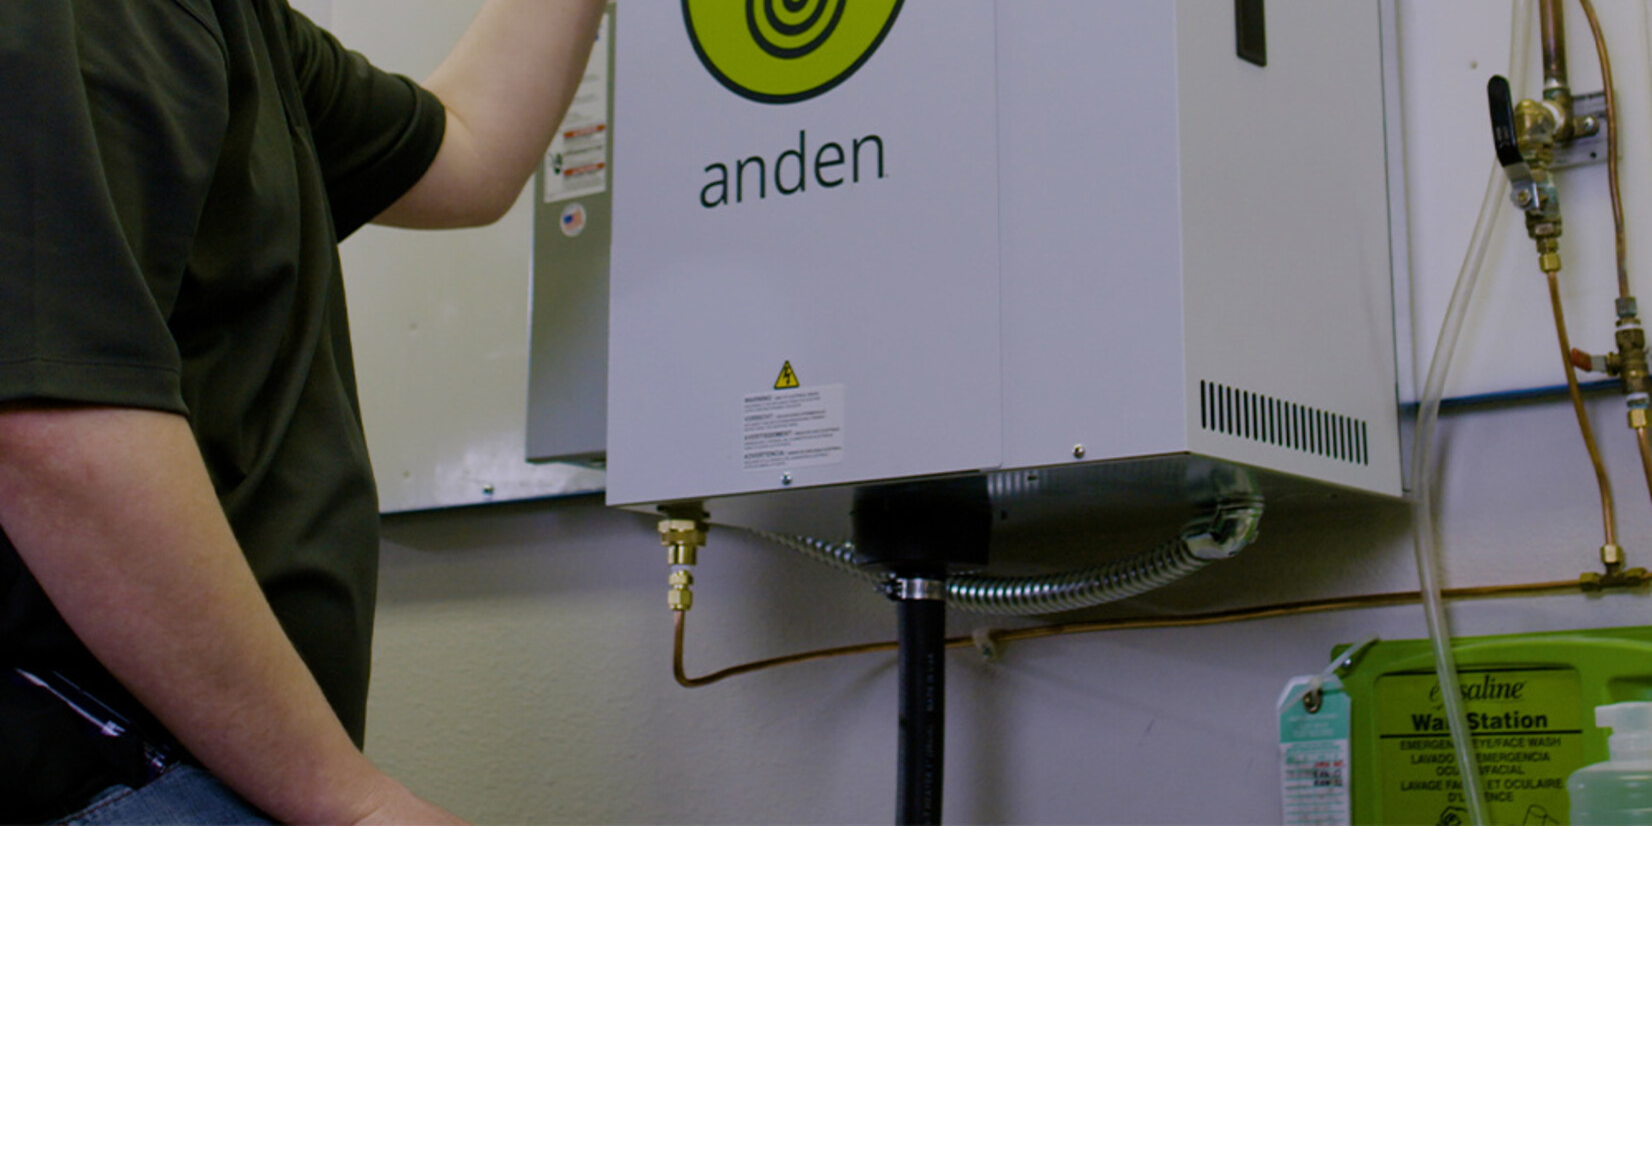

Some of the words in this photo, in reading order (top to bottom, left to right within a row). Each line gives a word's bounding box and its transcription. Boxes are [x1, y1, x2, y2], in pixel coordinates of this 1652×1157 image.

[700, 129, 884, 209] anden
[1466, 711, 1548, 730] Station
[1527, 736, 1562, 747] WASH
[1410, 753, 1455, 765] LAVADO
[1401, 779, 1443, 791] LAVAGE
[1488, 779, 1501, 790] ET
[1504, 778, 1563, 790] OCULAIRE
